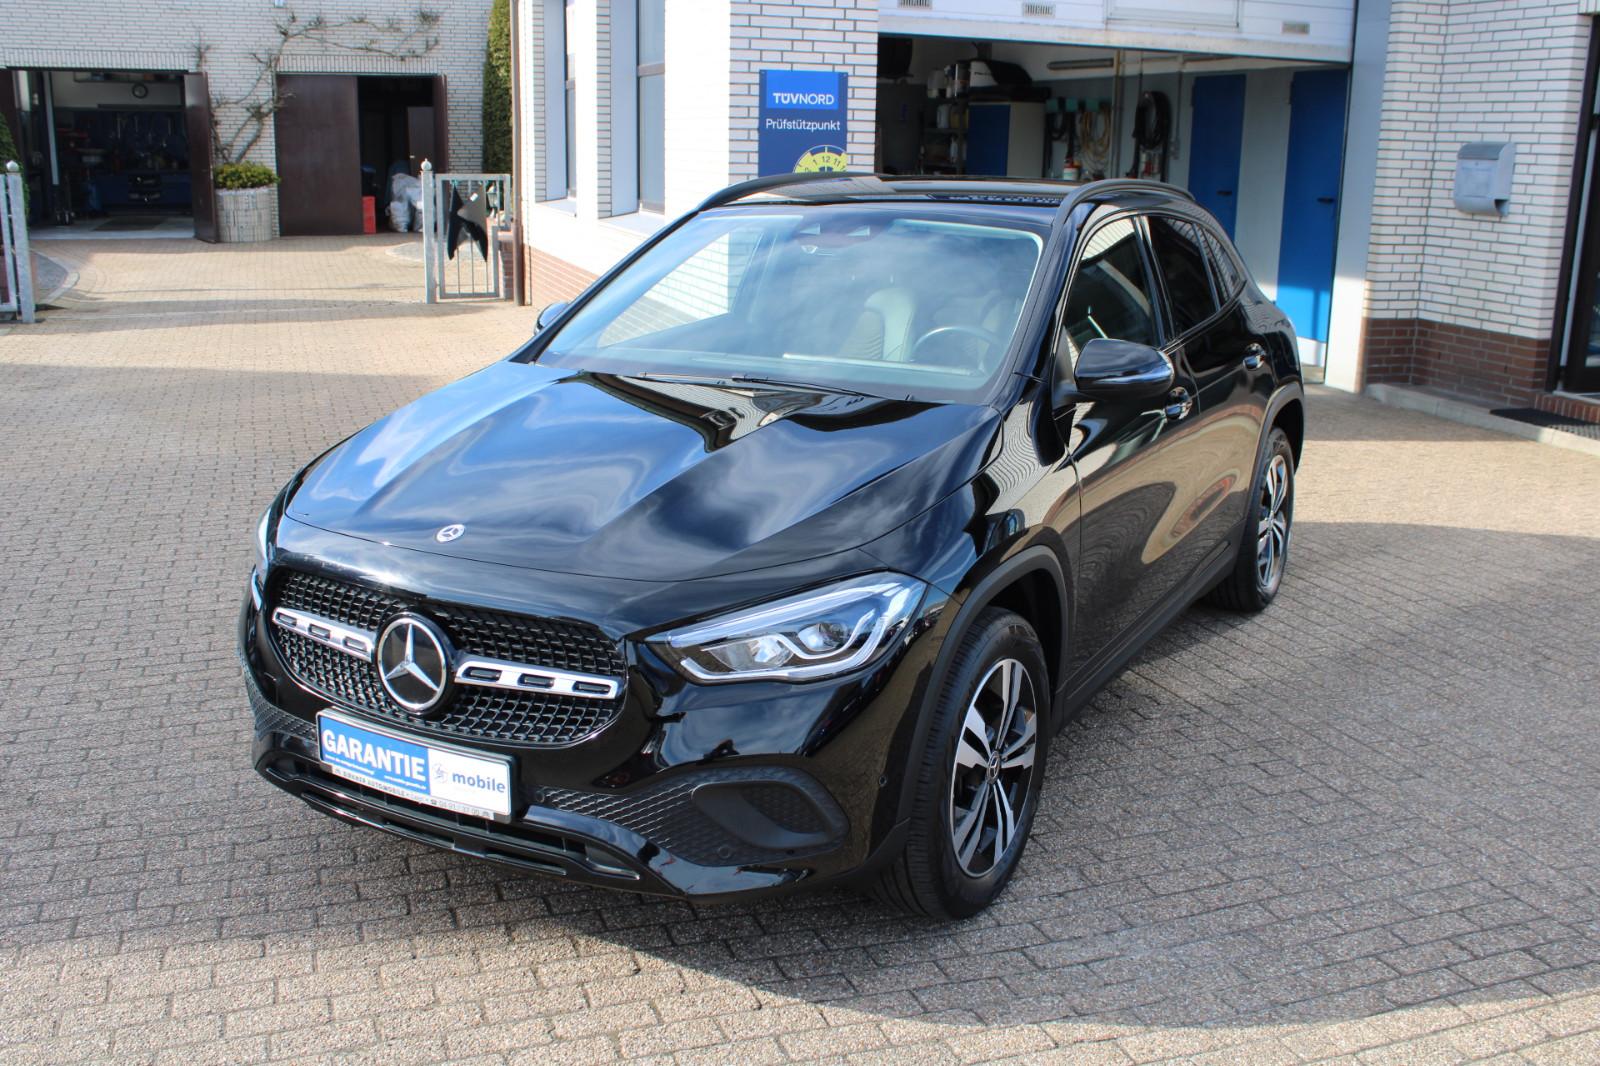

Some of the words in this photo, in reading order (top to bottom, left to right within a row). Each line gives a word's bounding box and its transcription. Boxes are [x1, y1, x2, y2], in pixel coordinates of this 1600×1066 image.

[765, 118, 841, 133] Prüfstützpunkt
[822, 155, 831, 163] 12
[322, 729, 427, 782] GARANTIE
[452, 771, 506, 793] mobile
